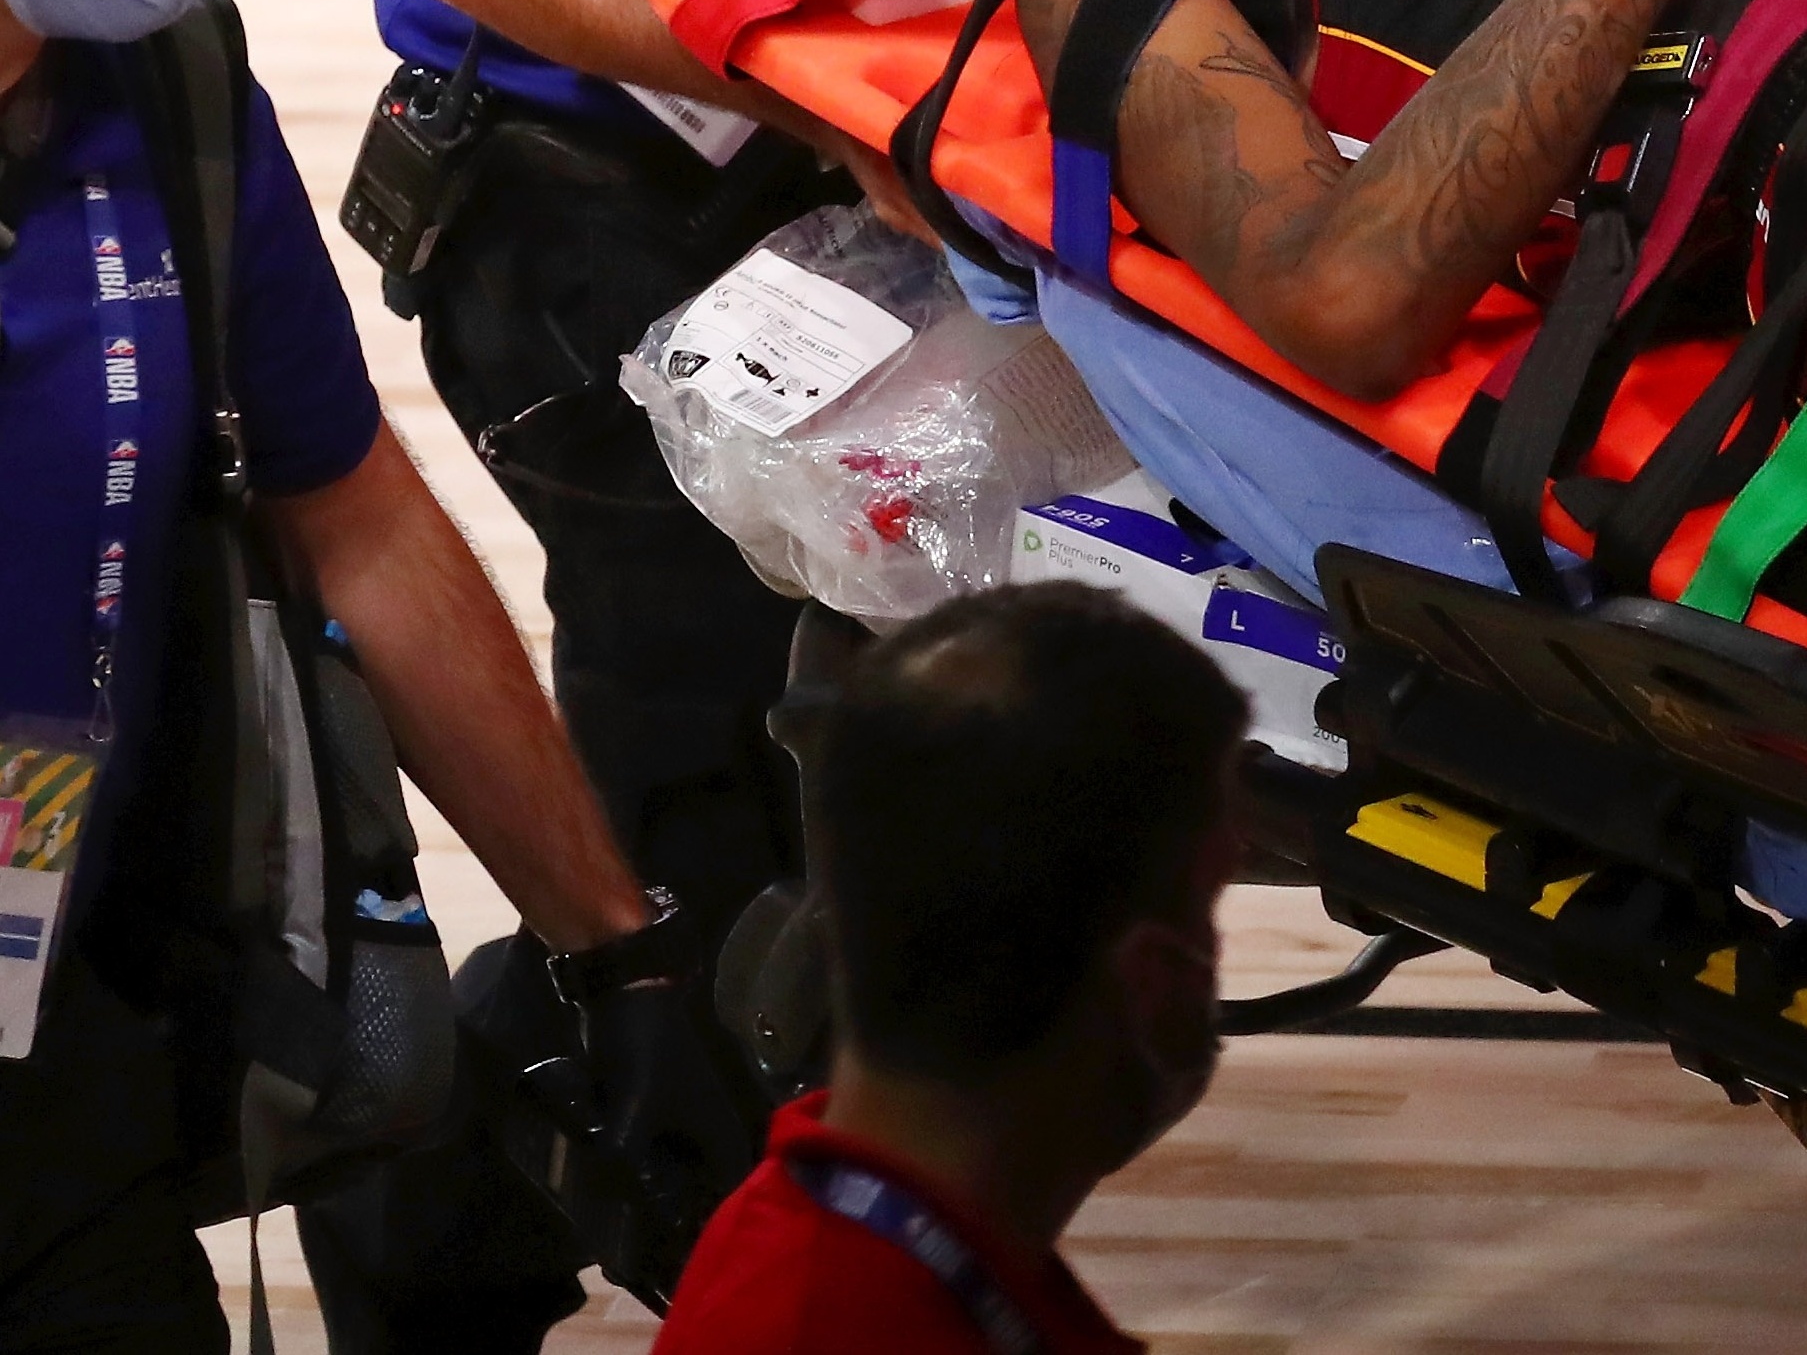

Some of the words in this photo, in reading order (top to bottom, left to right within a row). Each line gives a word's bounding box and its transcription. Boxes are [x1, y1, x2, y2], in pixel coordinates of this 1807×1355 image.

[95, 256, 129, 302] NBA
[105, 357, 139, 405] NBA
[104, 460, 136, 507] NBA
[1048, 549, 1073, 569] Plus
[1050, 537, 1121, 574] PremierPro
[1230, 609, 1245, 632] L
